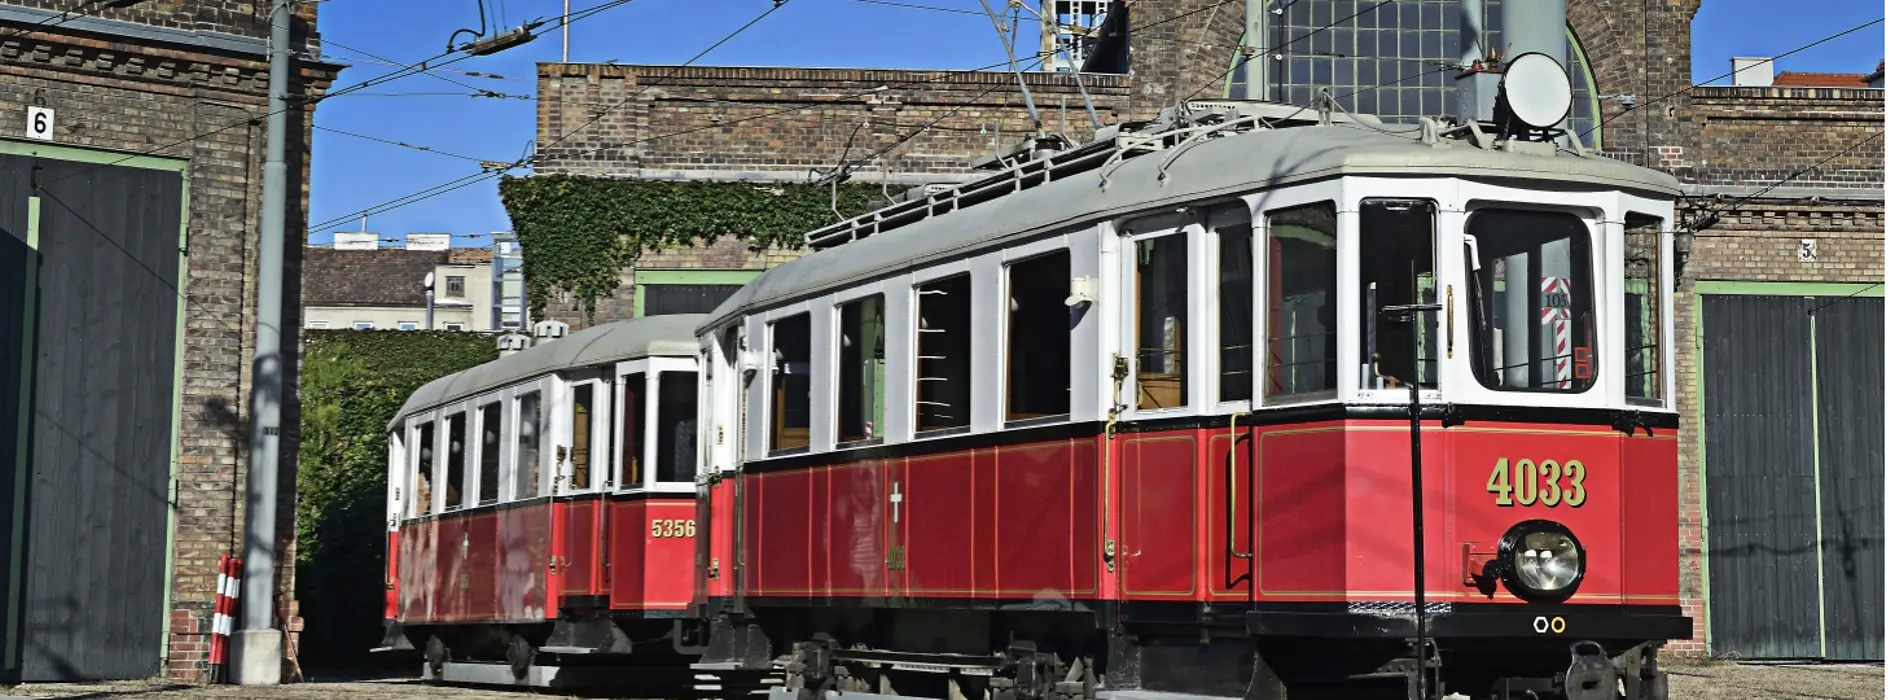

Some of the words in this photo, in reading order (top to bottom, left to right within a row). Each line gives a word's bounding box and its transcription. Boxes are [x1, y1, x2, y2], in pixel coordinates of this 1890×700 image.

[35, 112, 46, 134] 6
[1802, 243, 1811, 258] 5
[1486, 457, 1587, 508] 4033
[652, 519, 696, 538] 5356
